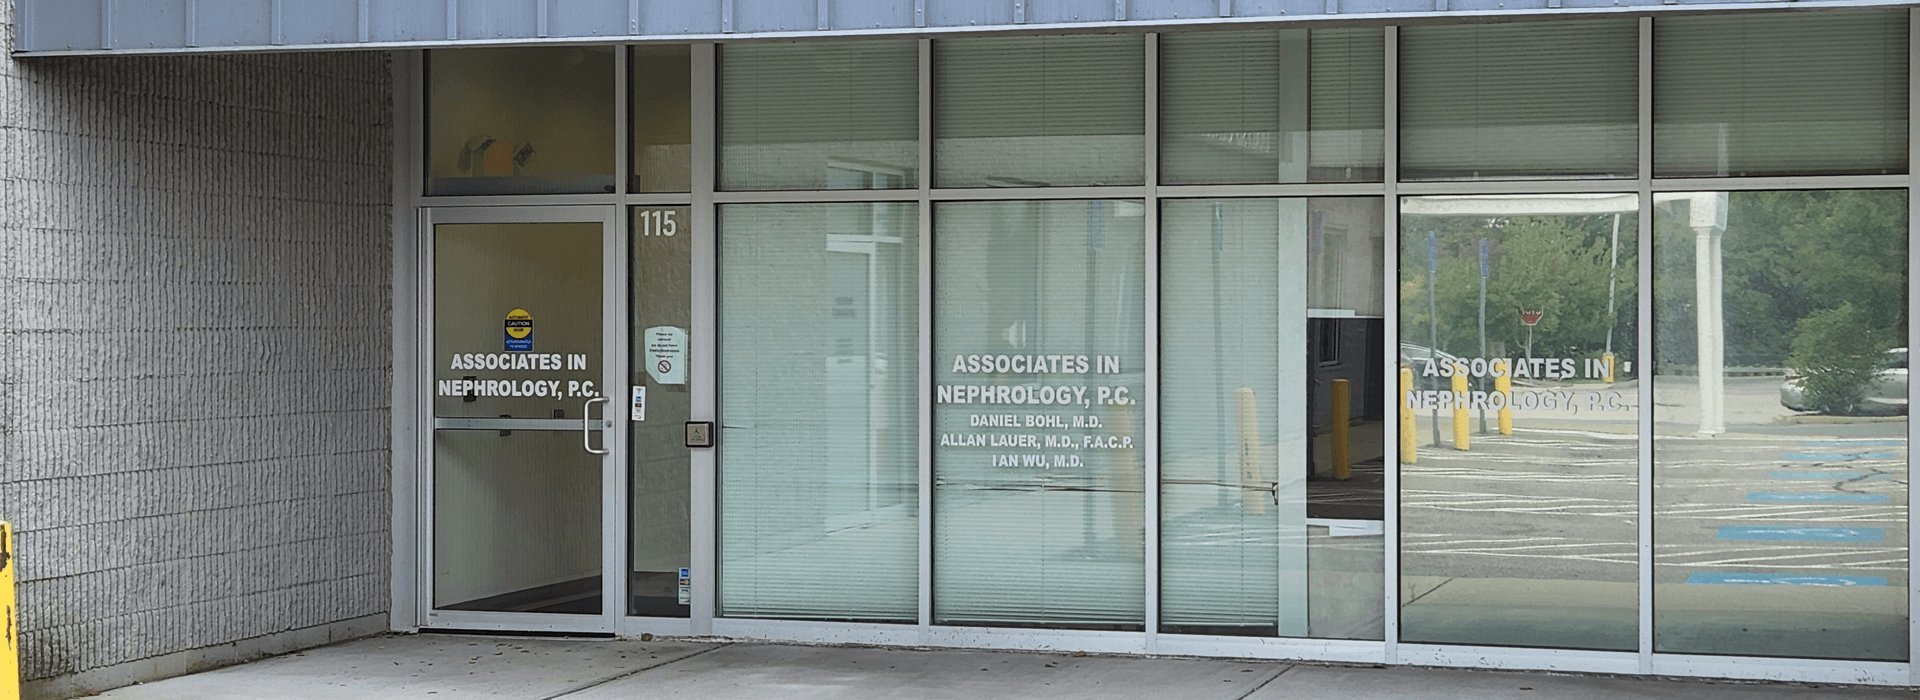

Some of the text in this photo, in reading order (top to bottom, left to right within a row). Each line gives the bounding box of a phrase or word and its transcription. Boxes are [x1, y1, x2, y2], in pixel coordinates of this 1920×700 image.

[640, 210, 676, 236] 115
[451, 353, 586, 370] ASSOCIATES IN
[952, 354, 1120, 374] ASSOCIATES IN
[1423, 358, 1611, 379] ASSOCIATES IN
[438, 380, 600, 400] NEPHROLOGY, P.C.
[937, 385, 1136, 409] NEPHROLOGY, P.C.
[1406, 390, 1630, 415] NEPHROLOGY, P.C.
[970, 414, 1103, 430] DANIEL BOHL, M.D.
[940, 434, 1134, 450] ALLAN LAUER, M.D., F.A.C.P.
[992, 454, 1084, 469] IAN WU, M.D.
